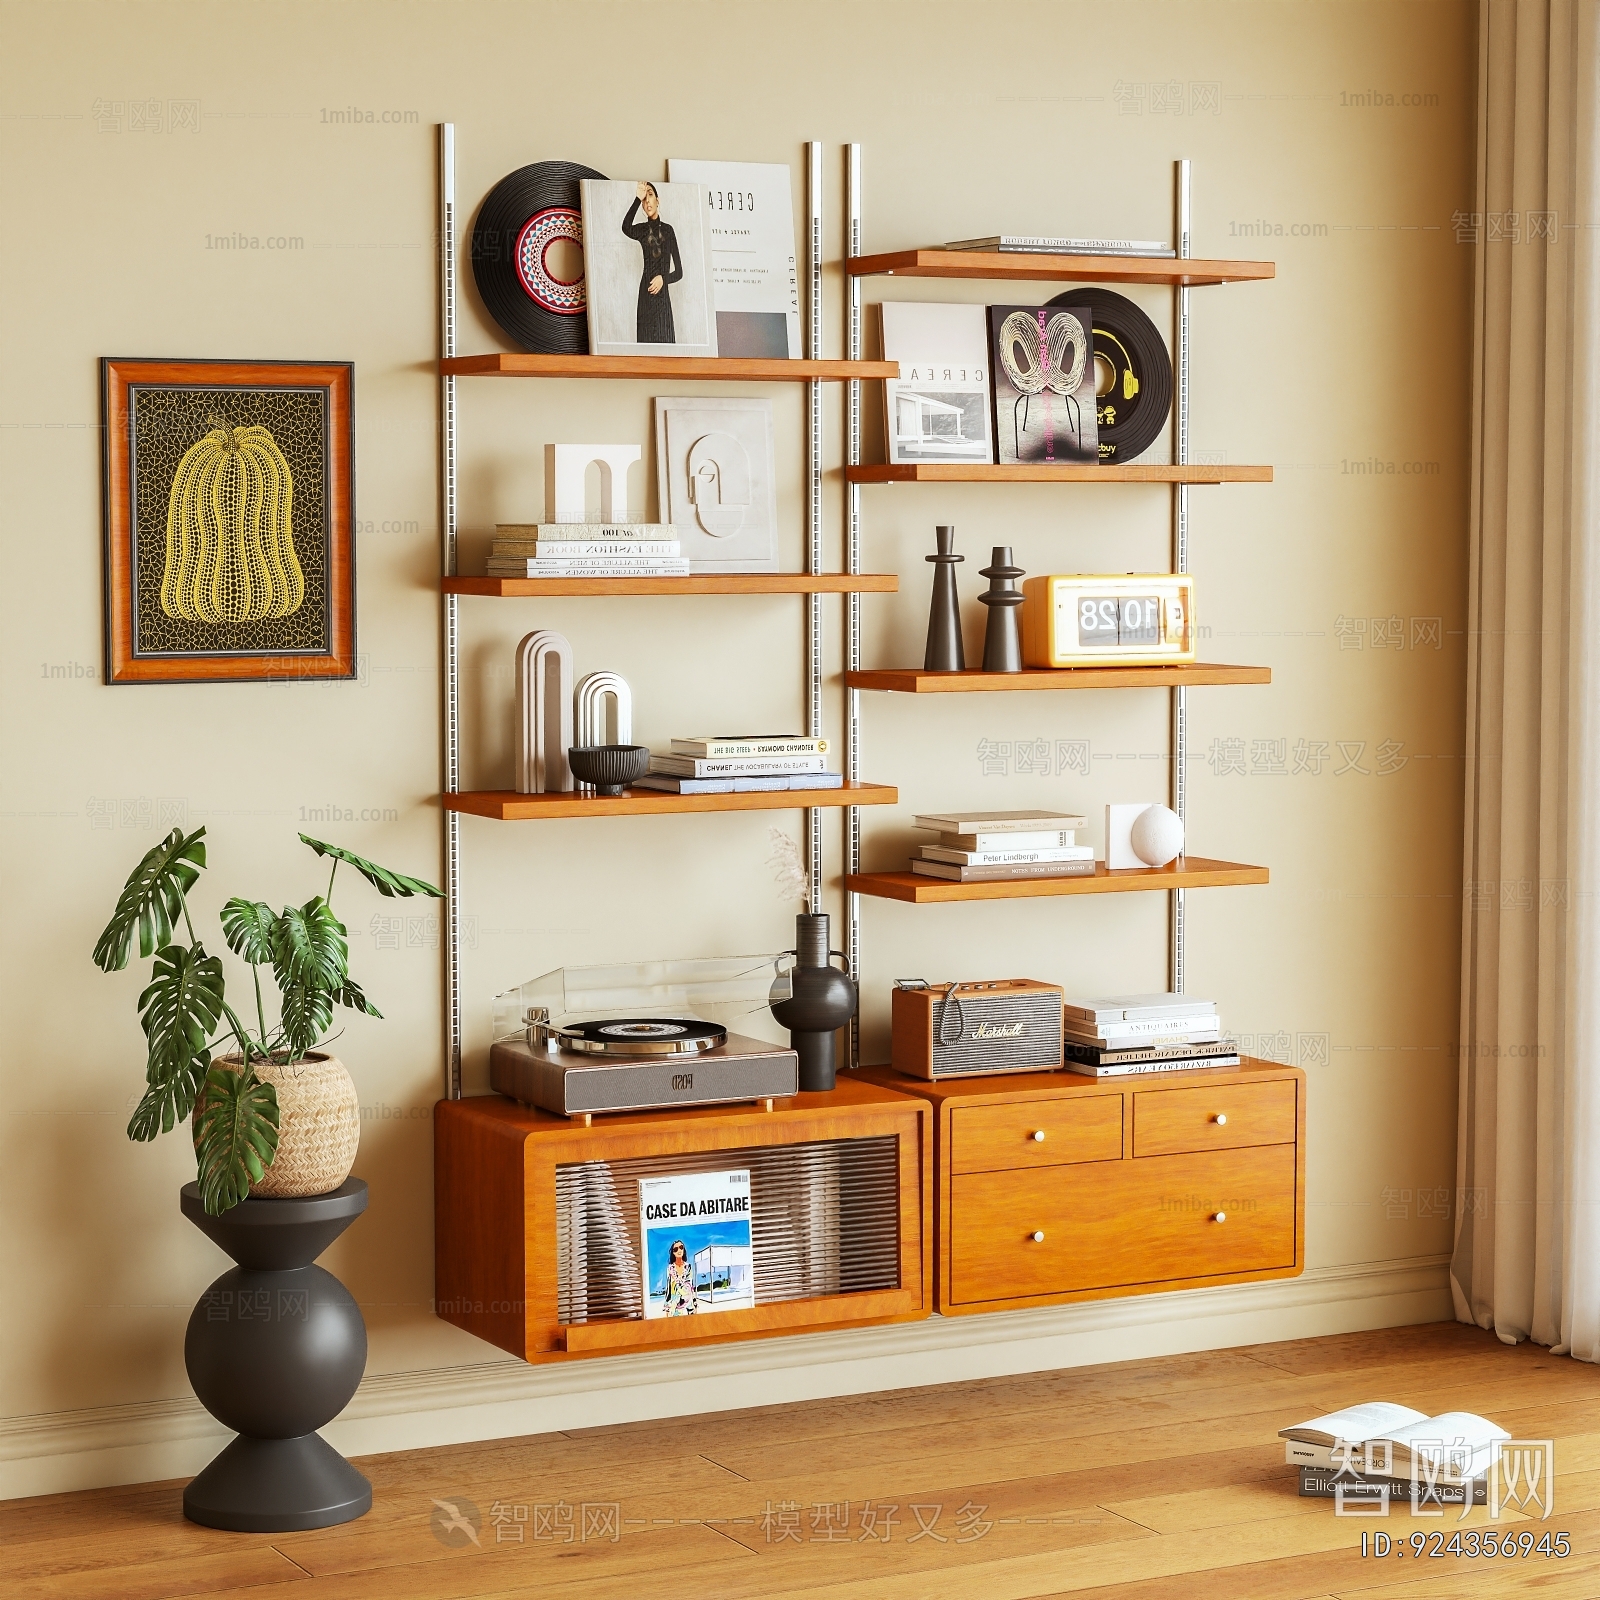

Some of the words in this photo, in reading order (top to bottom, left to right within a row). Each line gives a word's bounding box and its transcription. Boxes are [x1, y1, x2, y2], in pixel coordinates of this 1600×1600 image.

[983, 854, 1001, 862] Peter
[1003, 852, 1039, 861] Lindbergh
[972, 1022, 1024, 1038] Marshall
[646, 1202, 677, 1220] CASE
[680, 1201, 696, 1217] DA
[698, 1196, 749, 1215] ABITARE
[1304, 1478, 1349, 1492] Elliott
[1355, 1480, 1402, 1495] Erwitt
[1408, 1483, 1464, 1500] Snaps
